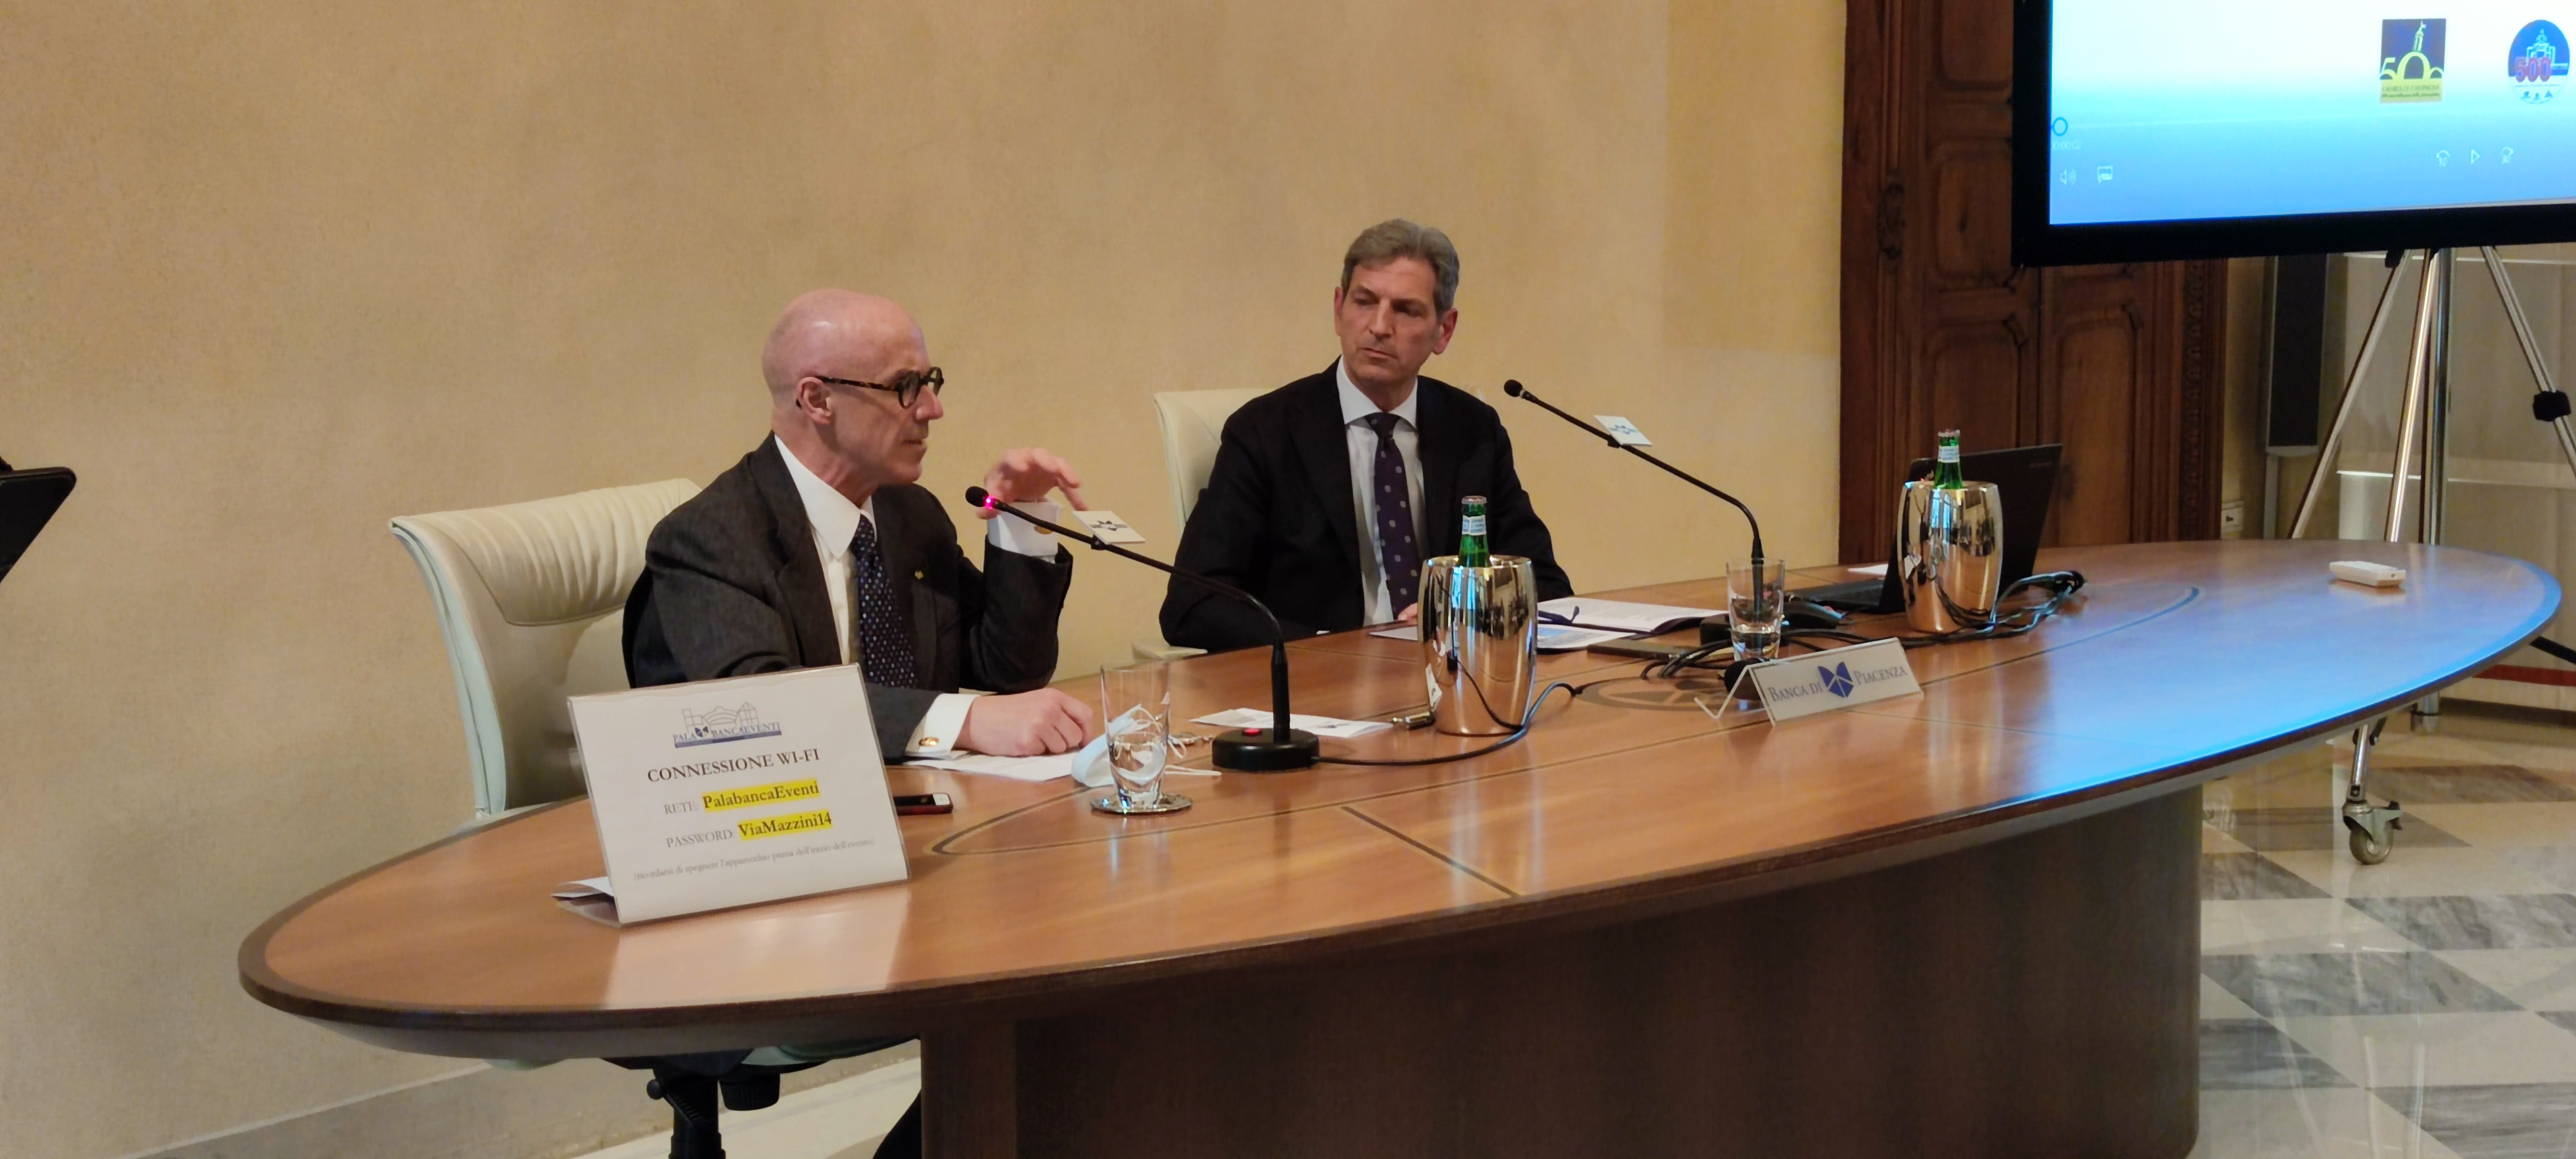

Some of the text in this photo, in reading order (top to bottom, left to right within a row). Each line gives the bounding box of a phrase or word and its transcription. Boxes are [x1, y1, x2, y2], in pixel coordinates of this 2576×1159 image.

[2515, 57, 2552, 83] 500
[1768, 666, 1908, 702] BANCA DI PIACENZA
[648, 749, 820, 782] CONNESSIONE WI-FI
[664, 781, 819, 815] RETE: PalabancaEventi
[666, 812, 832, 848] PASSWORD: ViaMazzini14
[675, 865, 683, 874] di
